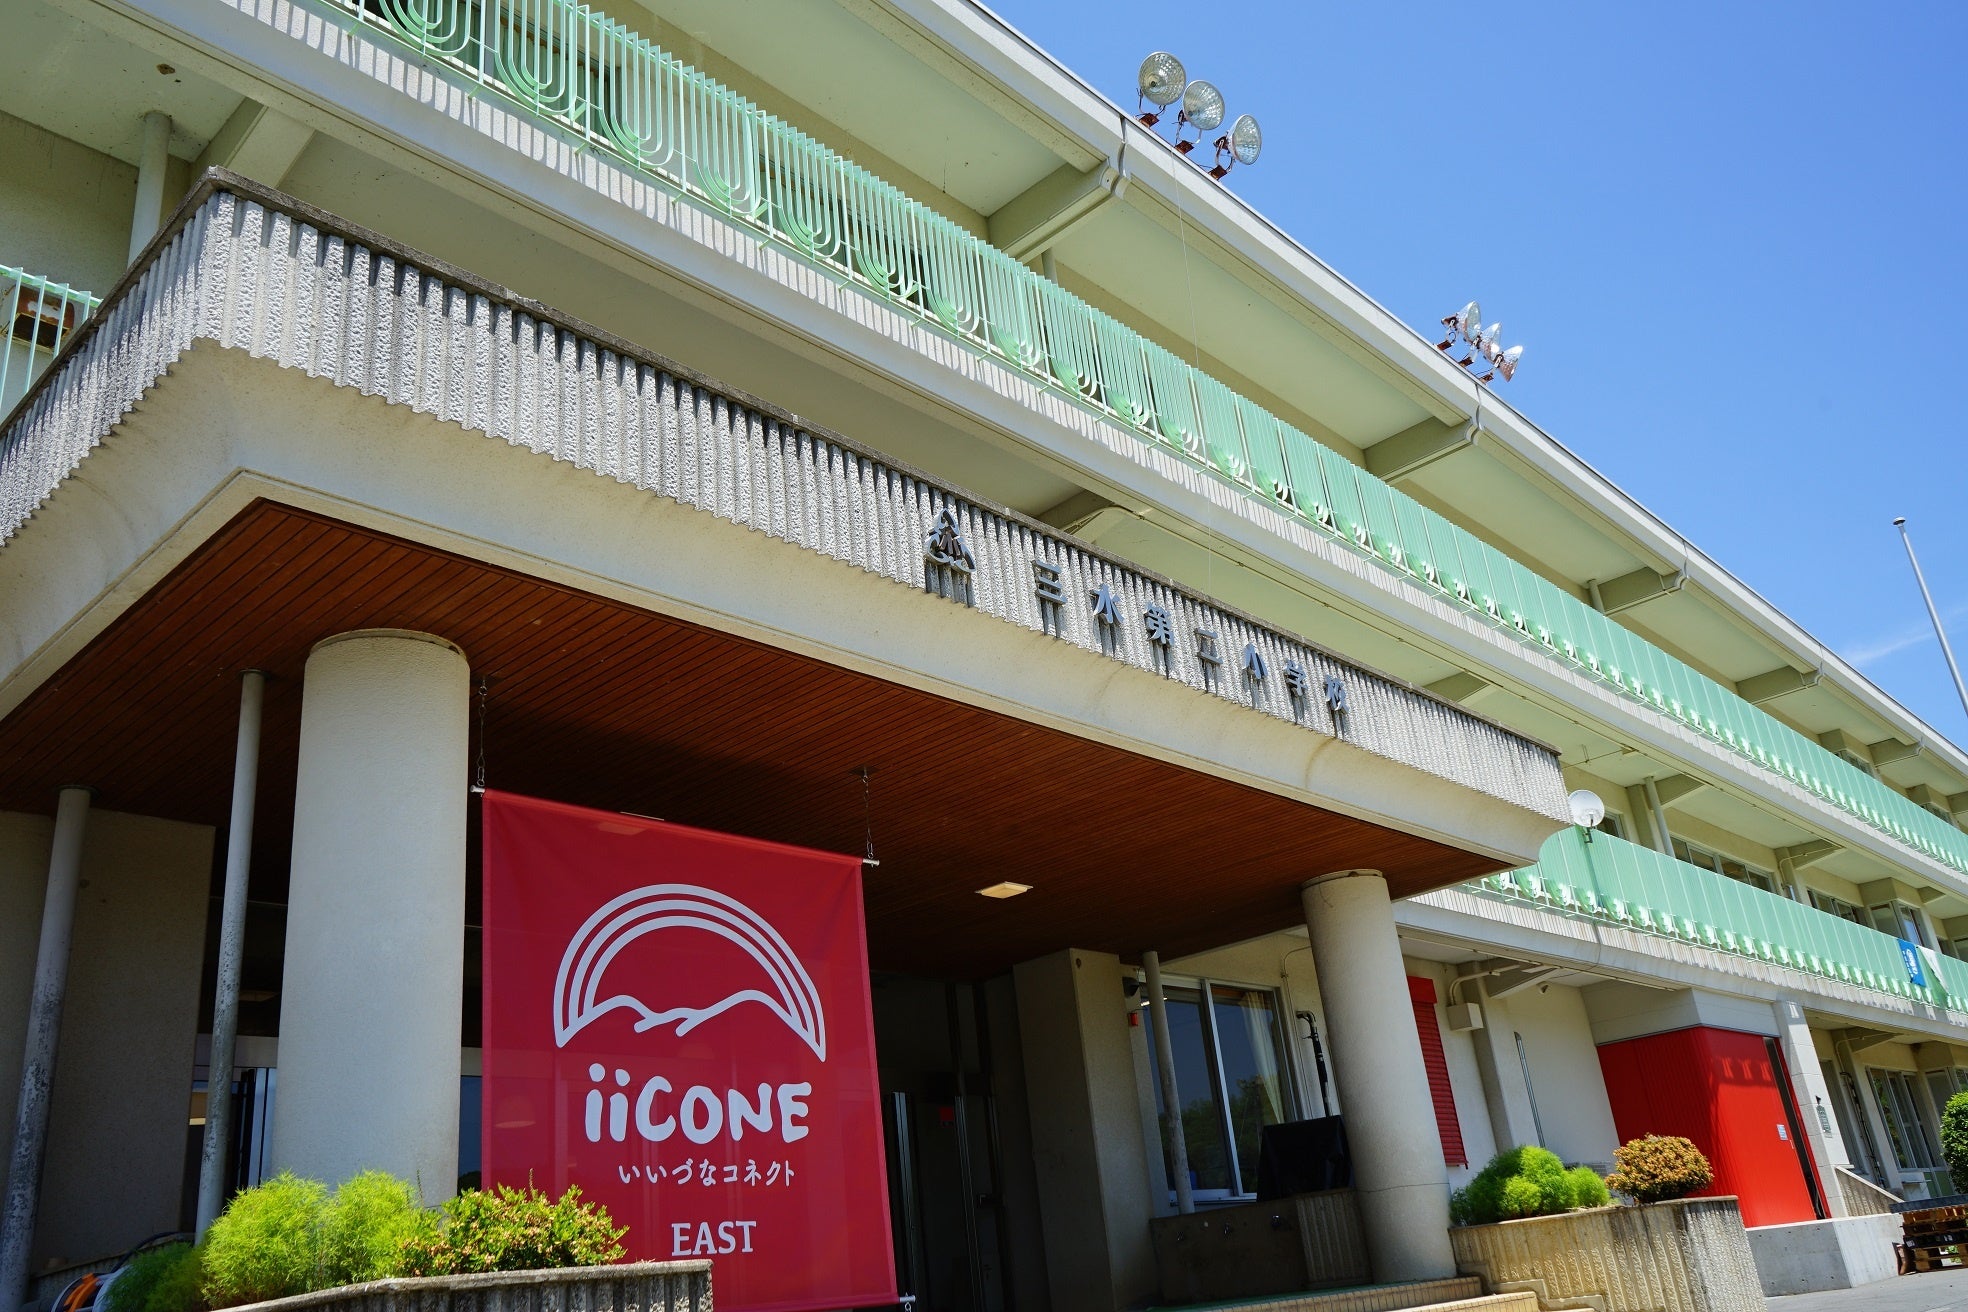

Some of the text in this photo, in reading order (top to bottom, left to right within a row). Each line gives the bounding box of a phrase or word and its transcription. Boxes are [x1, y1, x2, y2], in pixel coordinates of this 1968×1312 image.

[1032, 559, 1350, 716] 三水第二小学校
[585, 1063, 812, 1144] iiCONE
[618, 1158, 795, 1187] いいづなコネクト
[671, 1220, 757, 1257] EAST
